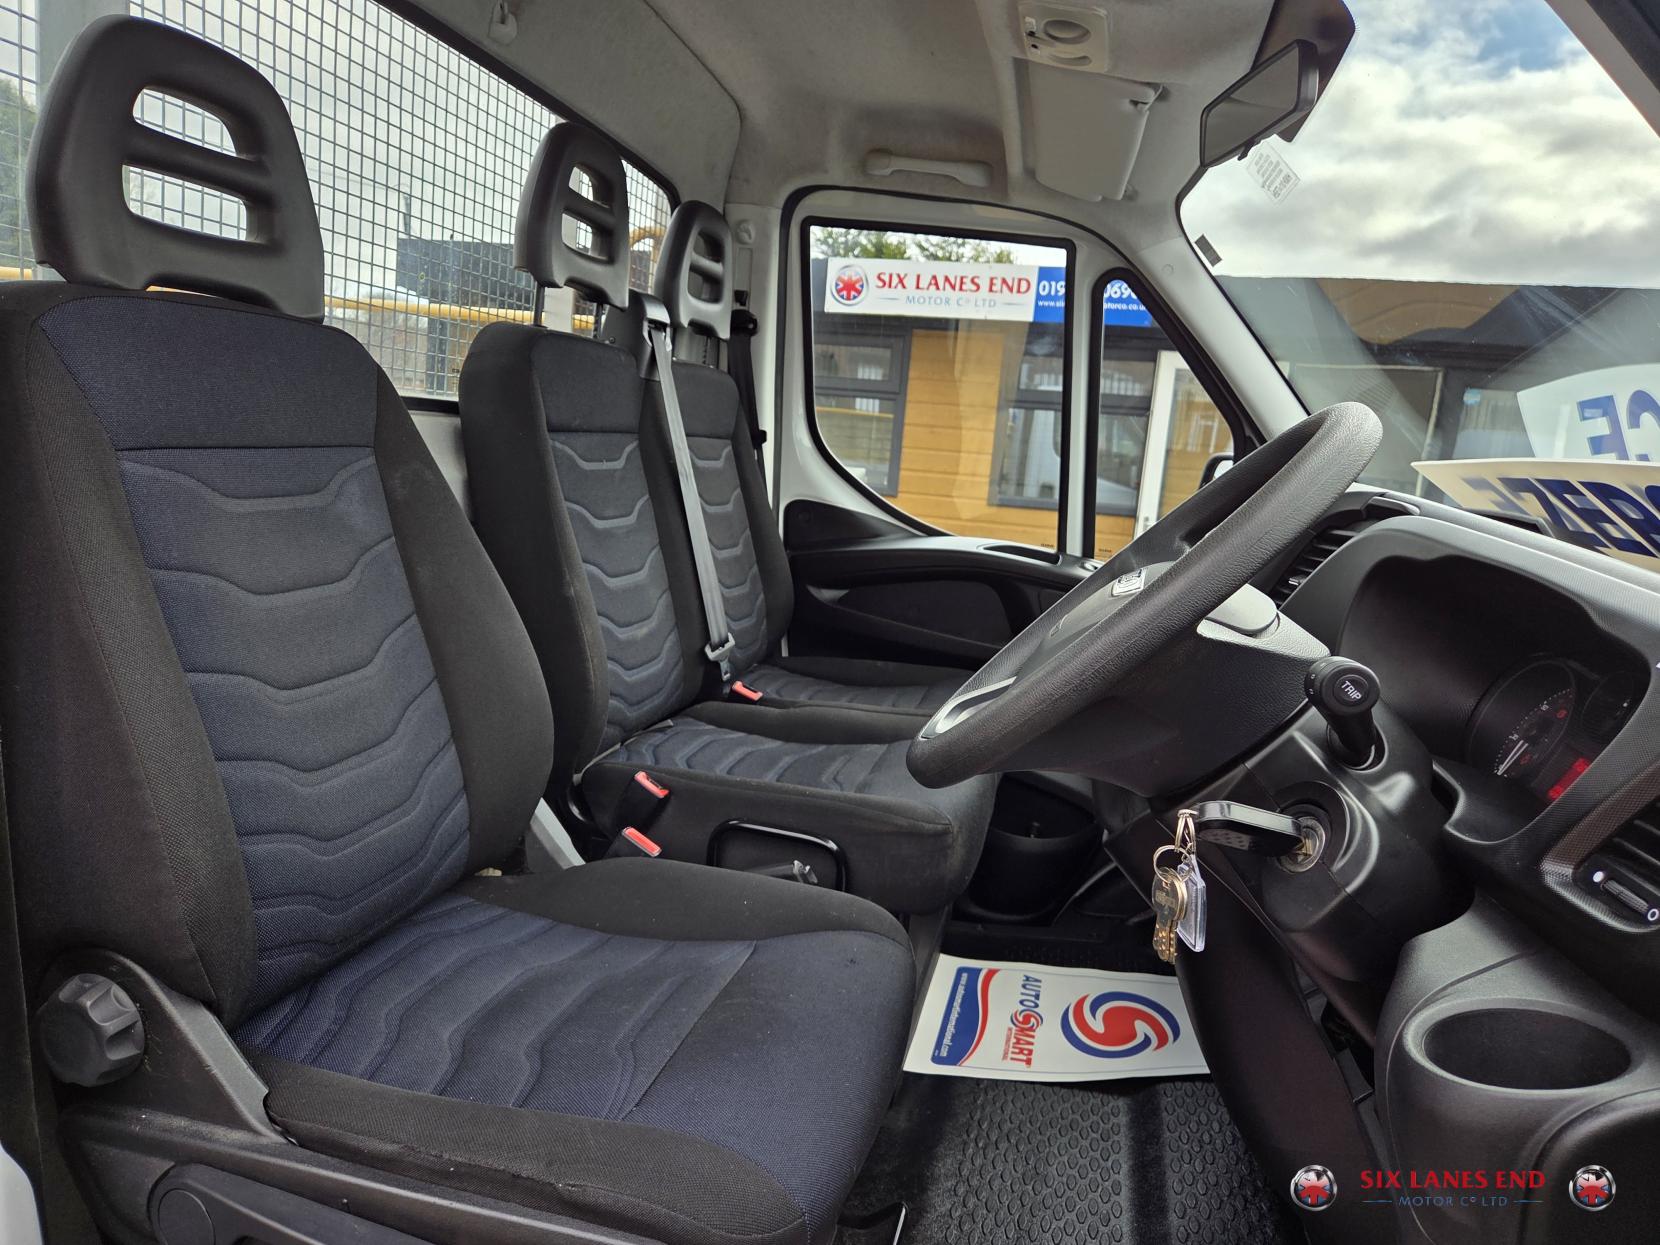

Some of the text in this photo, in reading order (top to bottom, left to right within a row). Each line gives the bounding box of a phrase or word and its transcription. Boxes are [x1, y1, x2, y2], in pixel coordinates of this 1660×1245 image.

[875, 271, 1031, 295] SIX LANES END
[905, 295, 950, 307] MOTOR
[974, 298, 997, 309] LTD
[1341, 680, 1362, 700] TRIP
